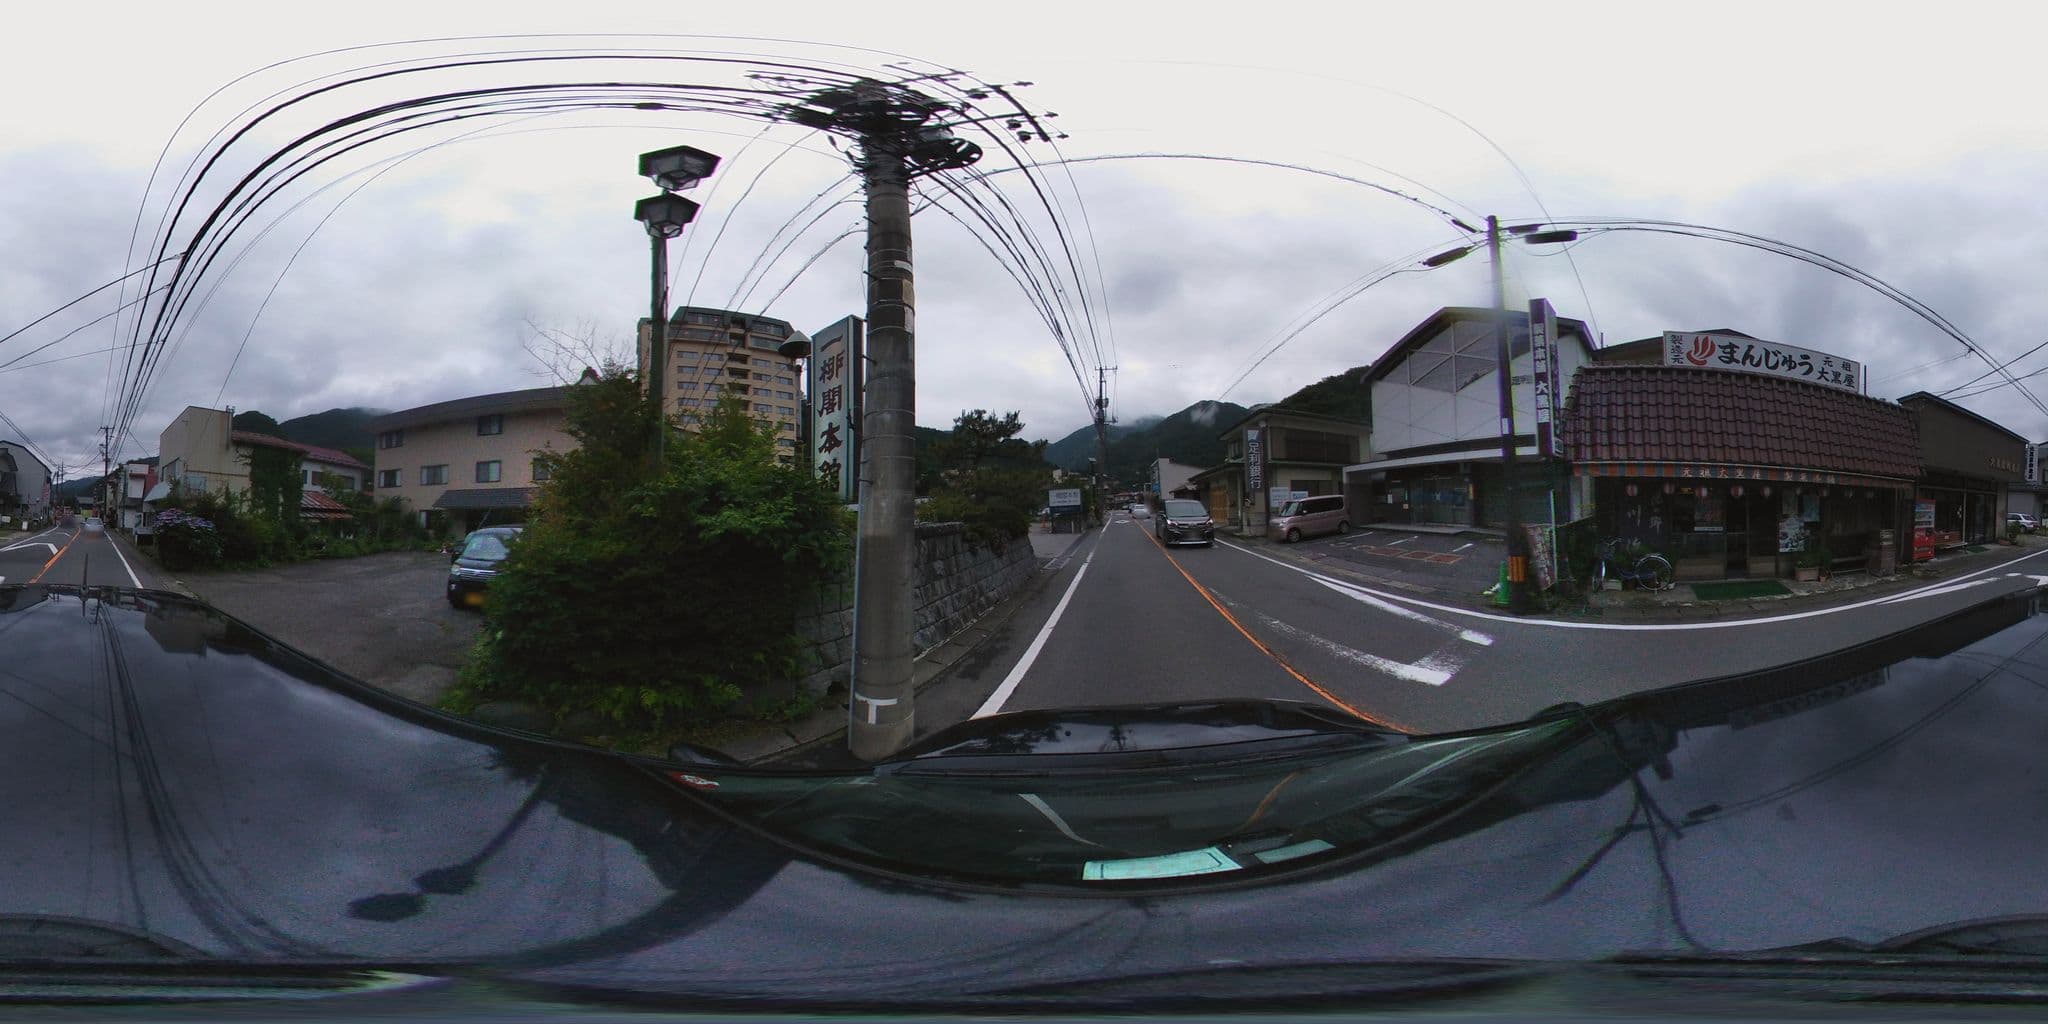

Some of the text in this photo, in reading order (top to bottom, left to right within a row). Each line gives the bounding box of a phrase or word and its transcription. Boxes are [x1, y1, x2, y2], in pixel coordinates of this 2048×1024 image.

[1670, 334, 1685, 365] 製造元
[1718, 342, 1814, 376] まんじゅう
[1823, 357, 1853, 372] 元祖
[1817, 367, 1856, 389] 大黒屋
[1248, 442, 1262, 489] 足利銀行
